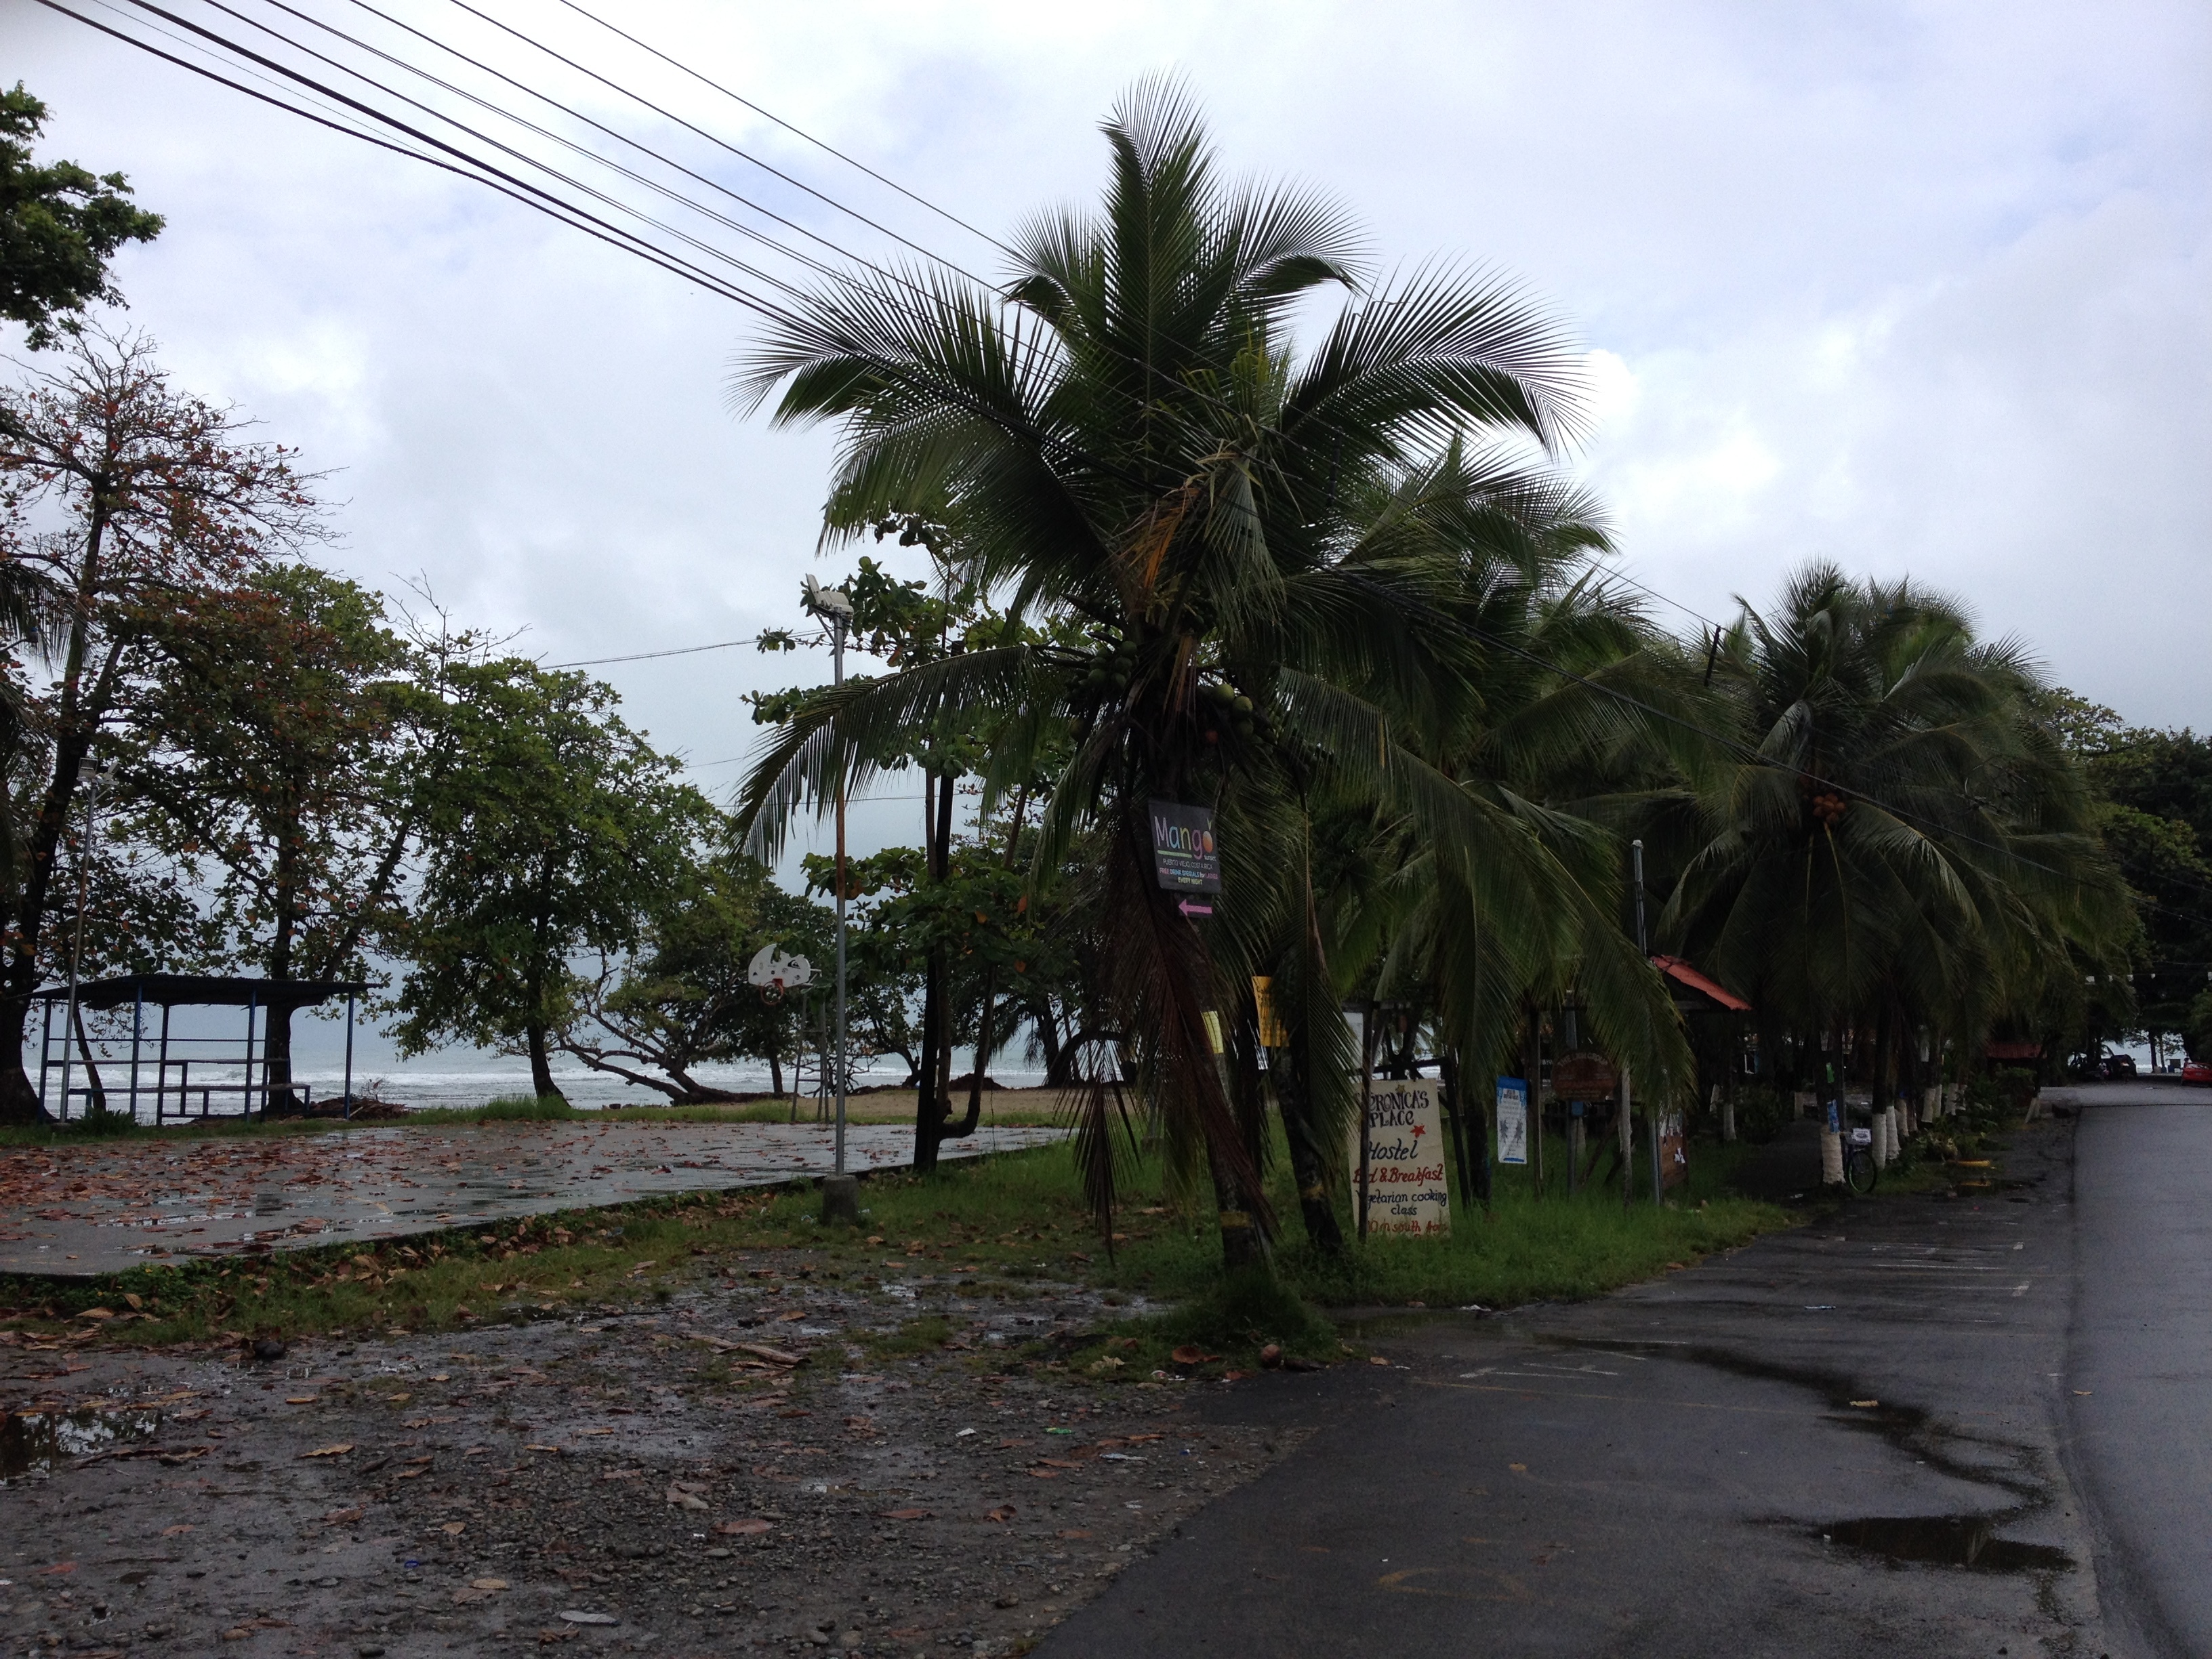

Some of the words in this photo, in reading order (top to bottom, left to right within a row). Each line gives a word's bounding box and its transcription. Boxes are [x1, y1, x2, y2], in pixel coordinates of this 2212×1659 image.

[1154, 816, 1213, 860] Mango
[1368, 1138, 1418, 1160] Hostel
[1353, 1167, 1378, 1184] Bd
[1379, 1167, 1388, 1183] &
[1387, 1163, 1443, 1187] Breakfast
[1412, 1189, 1447, 1206] cooking
[1391, 1204, 1417, 1215] class
